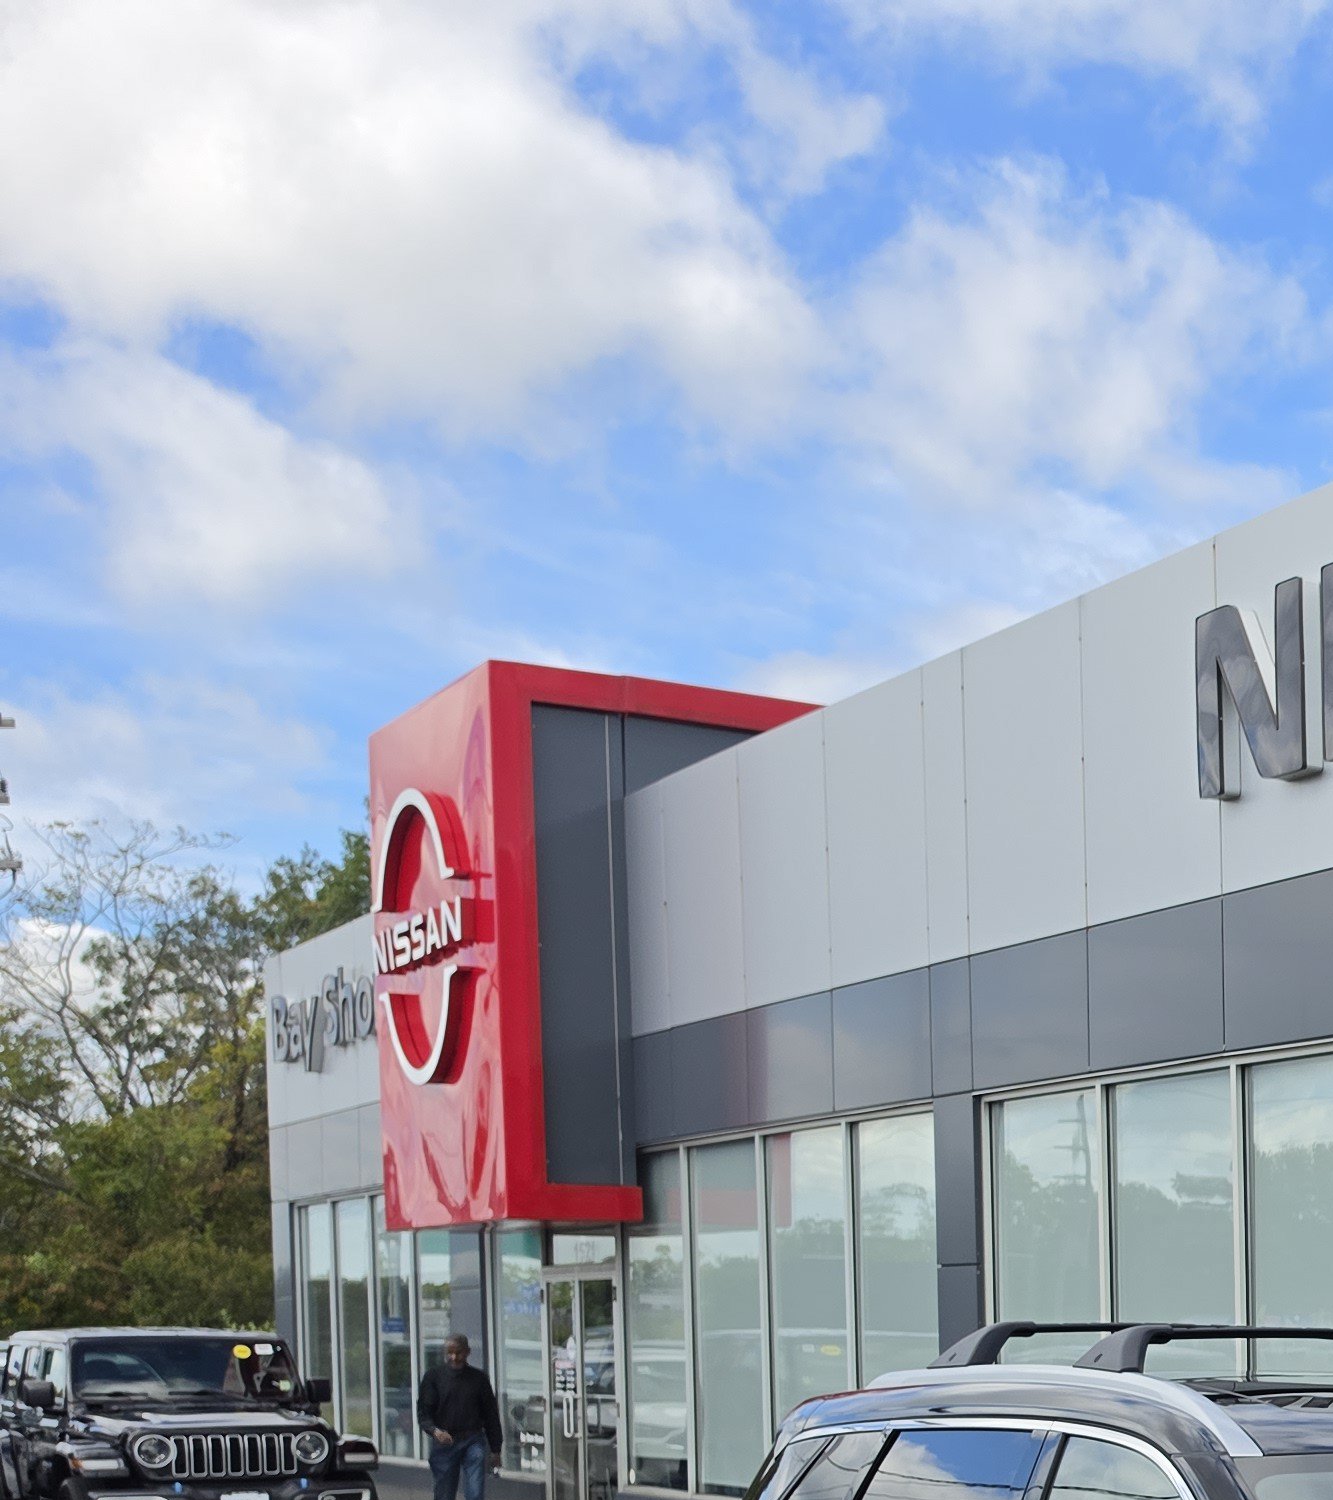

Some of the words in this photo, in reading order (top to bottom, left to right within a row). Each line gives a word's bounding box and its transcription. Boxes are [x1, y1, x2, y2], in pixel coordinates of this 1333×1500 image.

[371, 896, 463, 977] NISSAN
[270, 994, 324, 1073] Bay
[321, 967, 377, 1047] Sho
